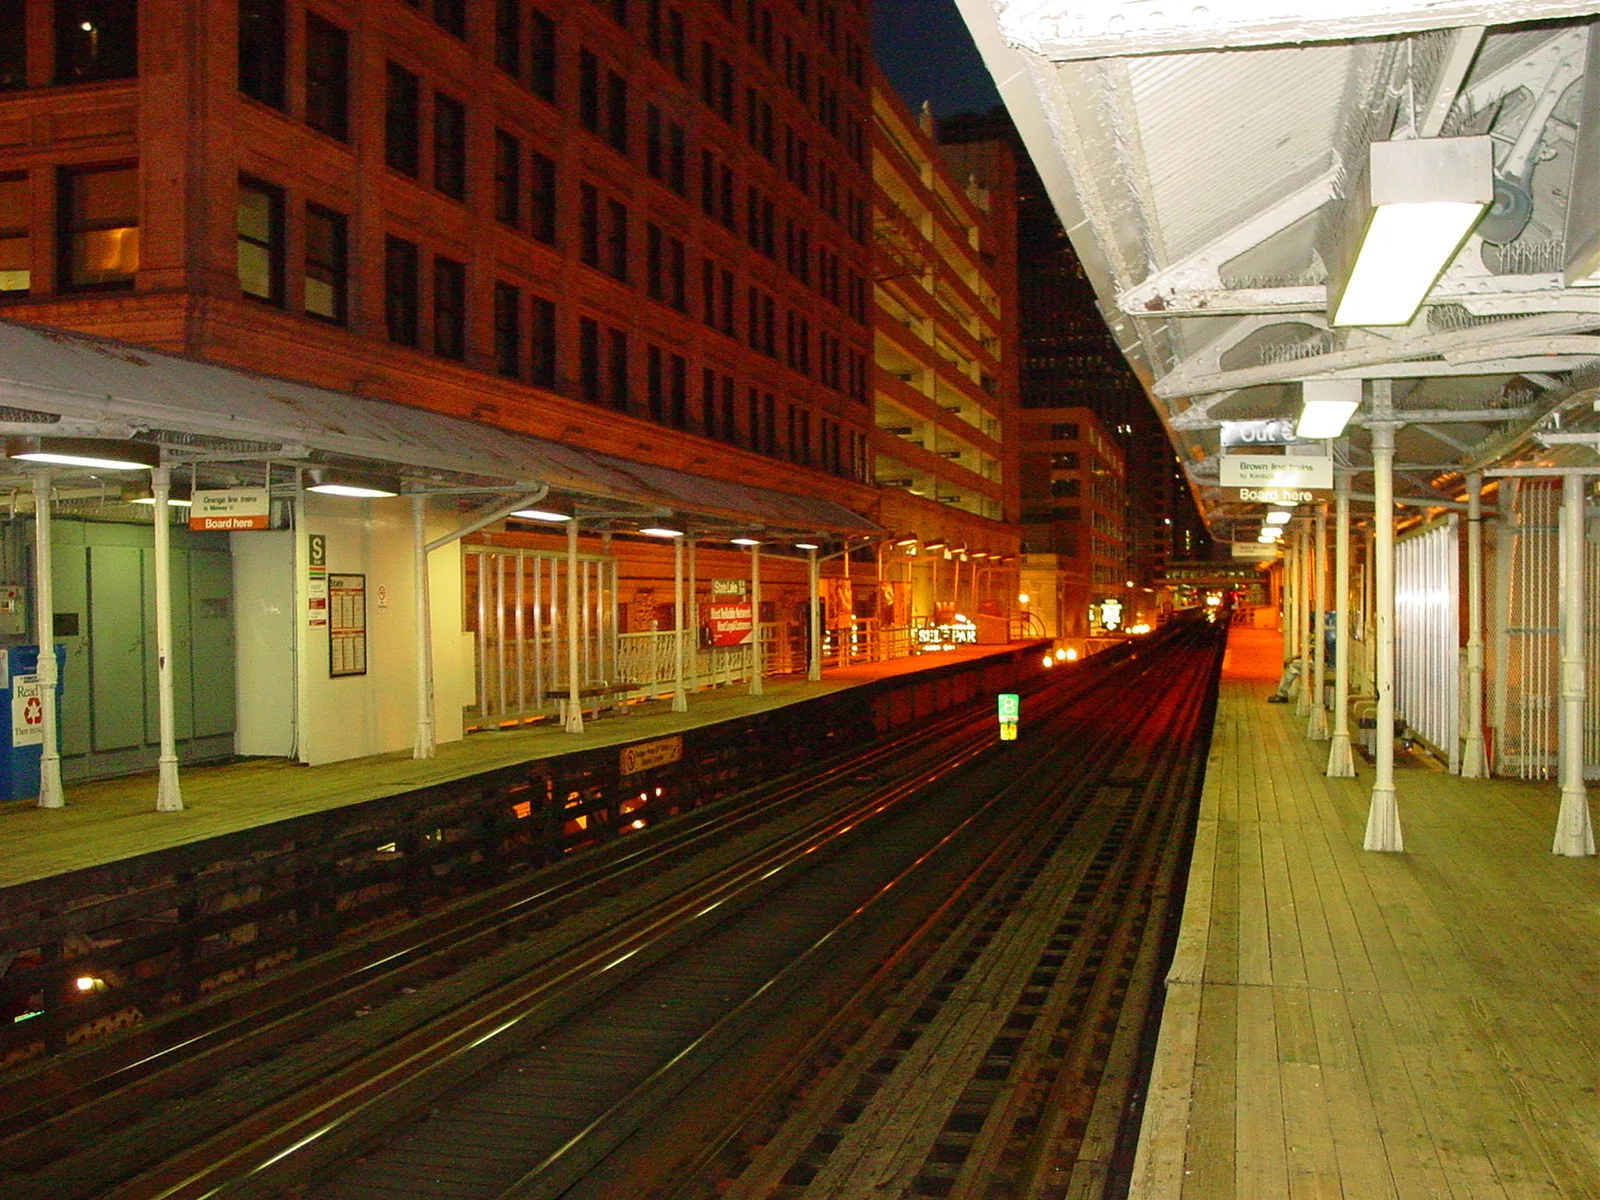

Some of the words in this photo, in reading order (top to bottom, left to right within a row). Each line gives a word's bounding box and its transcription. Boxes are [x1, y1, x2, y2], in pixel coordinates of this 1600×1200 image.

[1241, 424, 1275, 442] Out
[1240, 462, 1268, 470] Brown
[203, 496, 226, 504] Orange
[1240, 488, 1278, 501] Board
[1283, 489, 1313, 501] here
[205, 518, 232, 529] Board
[233, 518, 253, 528] here
[312, 537, 323, 560] S
[17, 684, 39, 698] Read
[1003, 698, 1015, 714] 8
